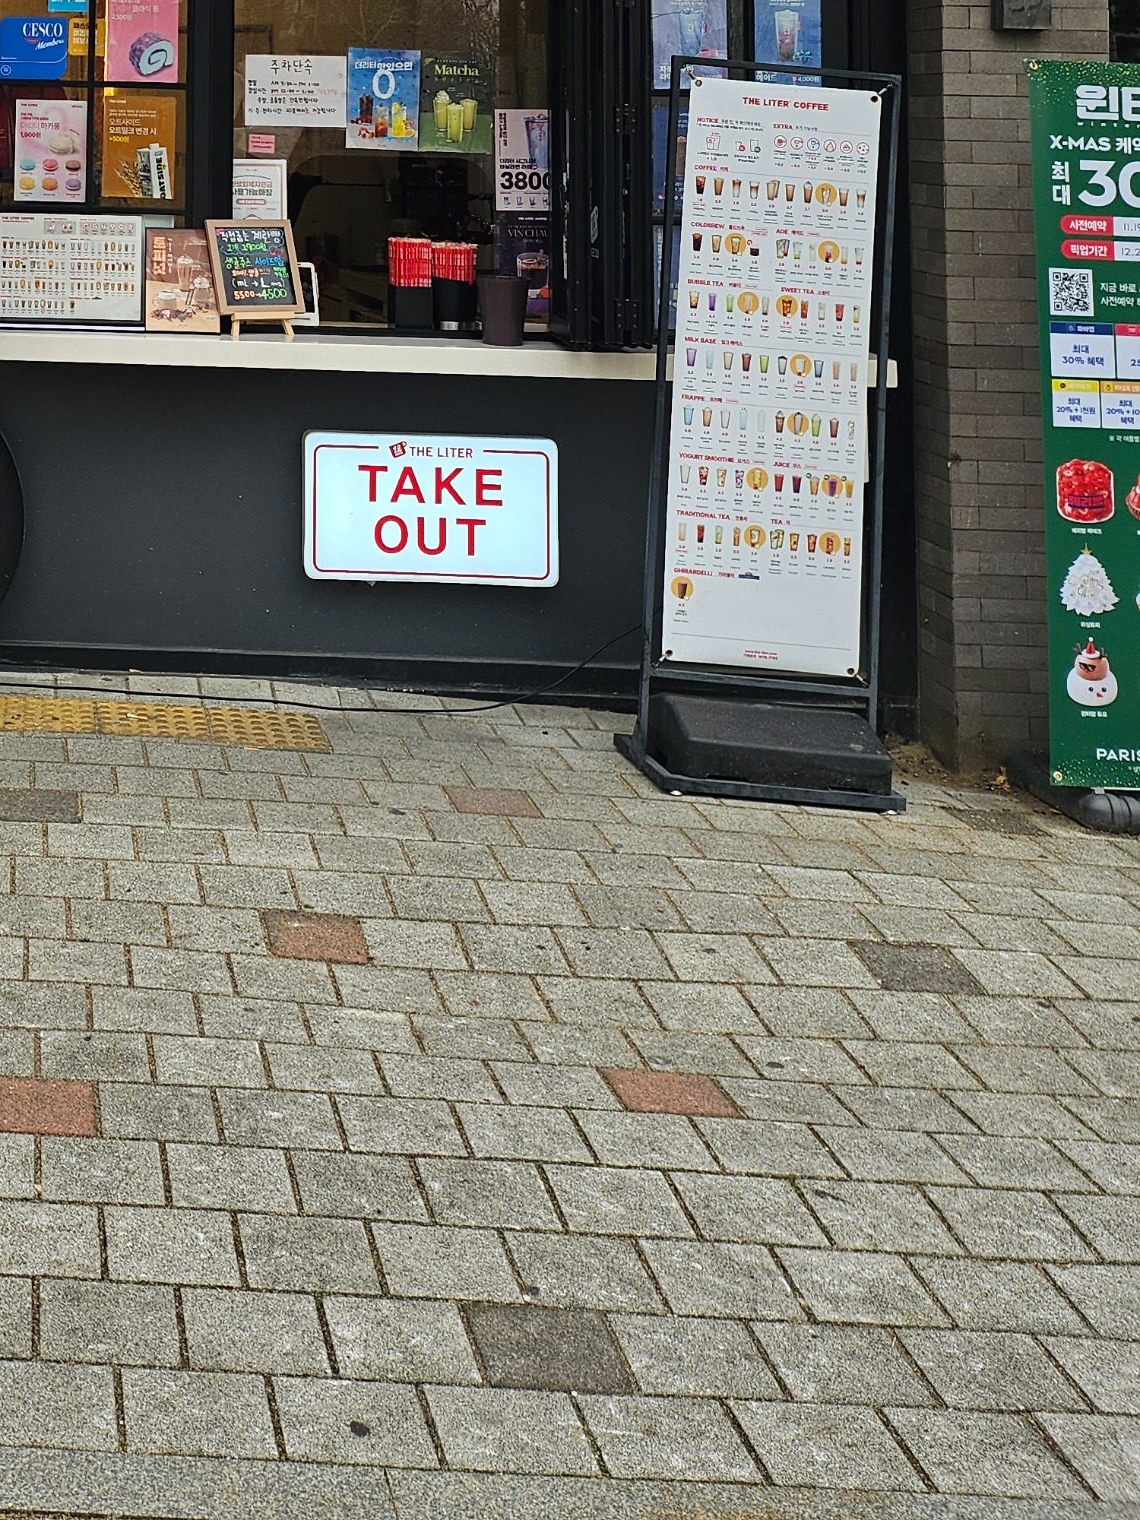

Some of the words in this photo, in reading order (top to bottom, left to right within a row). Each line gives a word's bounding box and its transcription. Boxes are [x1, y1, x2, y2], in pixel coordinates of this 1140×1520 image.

[22, 22, 63, 37] CESCO
[270, 58, 313, 75] 주차단속
[354, 61, 376, 70] 더리터
[376, 61, 413, 71] 맛있으면
[433, 64, 480, 77] Matcha
[742, 96, 761, 106] THE
[763, 98, 789, 108] LITER
[793, 101, 829, 111] COFFEE
[40, 122, 60, 130] 마카롱
[108, 117, 141, 127] 오트사이드
[108, 126, 135, 135] 오트밀크
[135, 127, 149, 136] 변경
[149, 127, 158, 136] 시
[1049, 134, 1112, 152] X-MAS
[155, 156, 167, 199] OATSIDE
[1051, 160, 1071, 206] 최대
[1069, 219, 1107, 232] 사전예약
[1070, 244, 1108, 257] 픽업기간
[1100, 282, 1118, 293] 지금
[1119, 283, 1137, 293] 바로
[261, 288, 288, 300] 4500
[1100, 296, 1135, 307] 사전예약
[1072, 343, 1090, 354] 최대
[1061, 356, 1085, 365] 30%
[1086, 356, 1105, 367] 혜택
[1067, 397, 1081, 406] 최대
[1118, 399, 1133, 407] 최대
[409, 446, 433, 458] THE
[437, 447, 474, 459] LITER
[357, 464, 503, 507] TAKE
[717, 512, 731, 520] TEA
[373, 514, 487, 557] OUT
